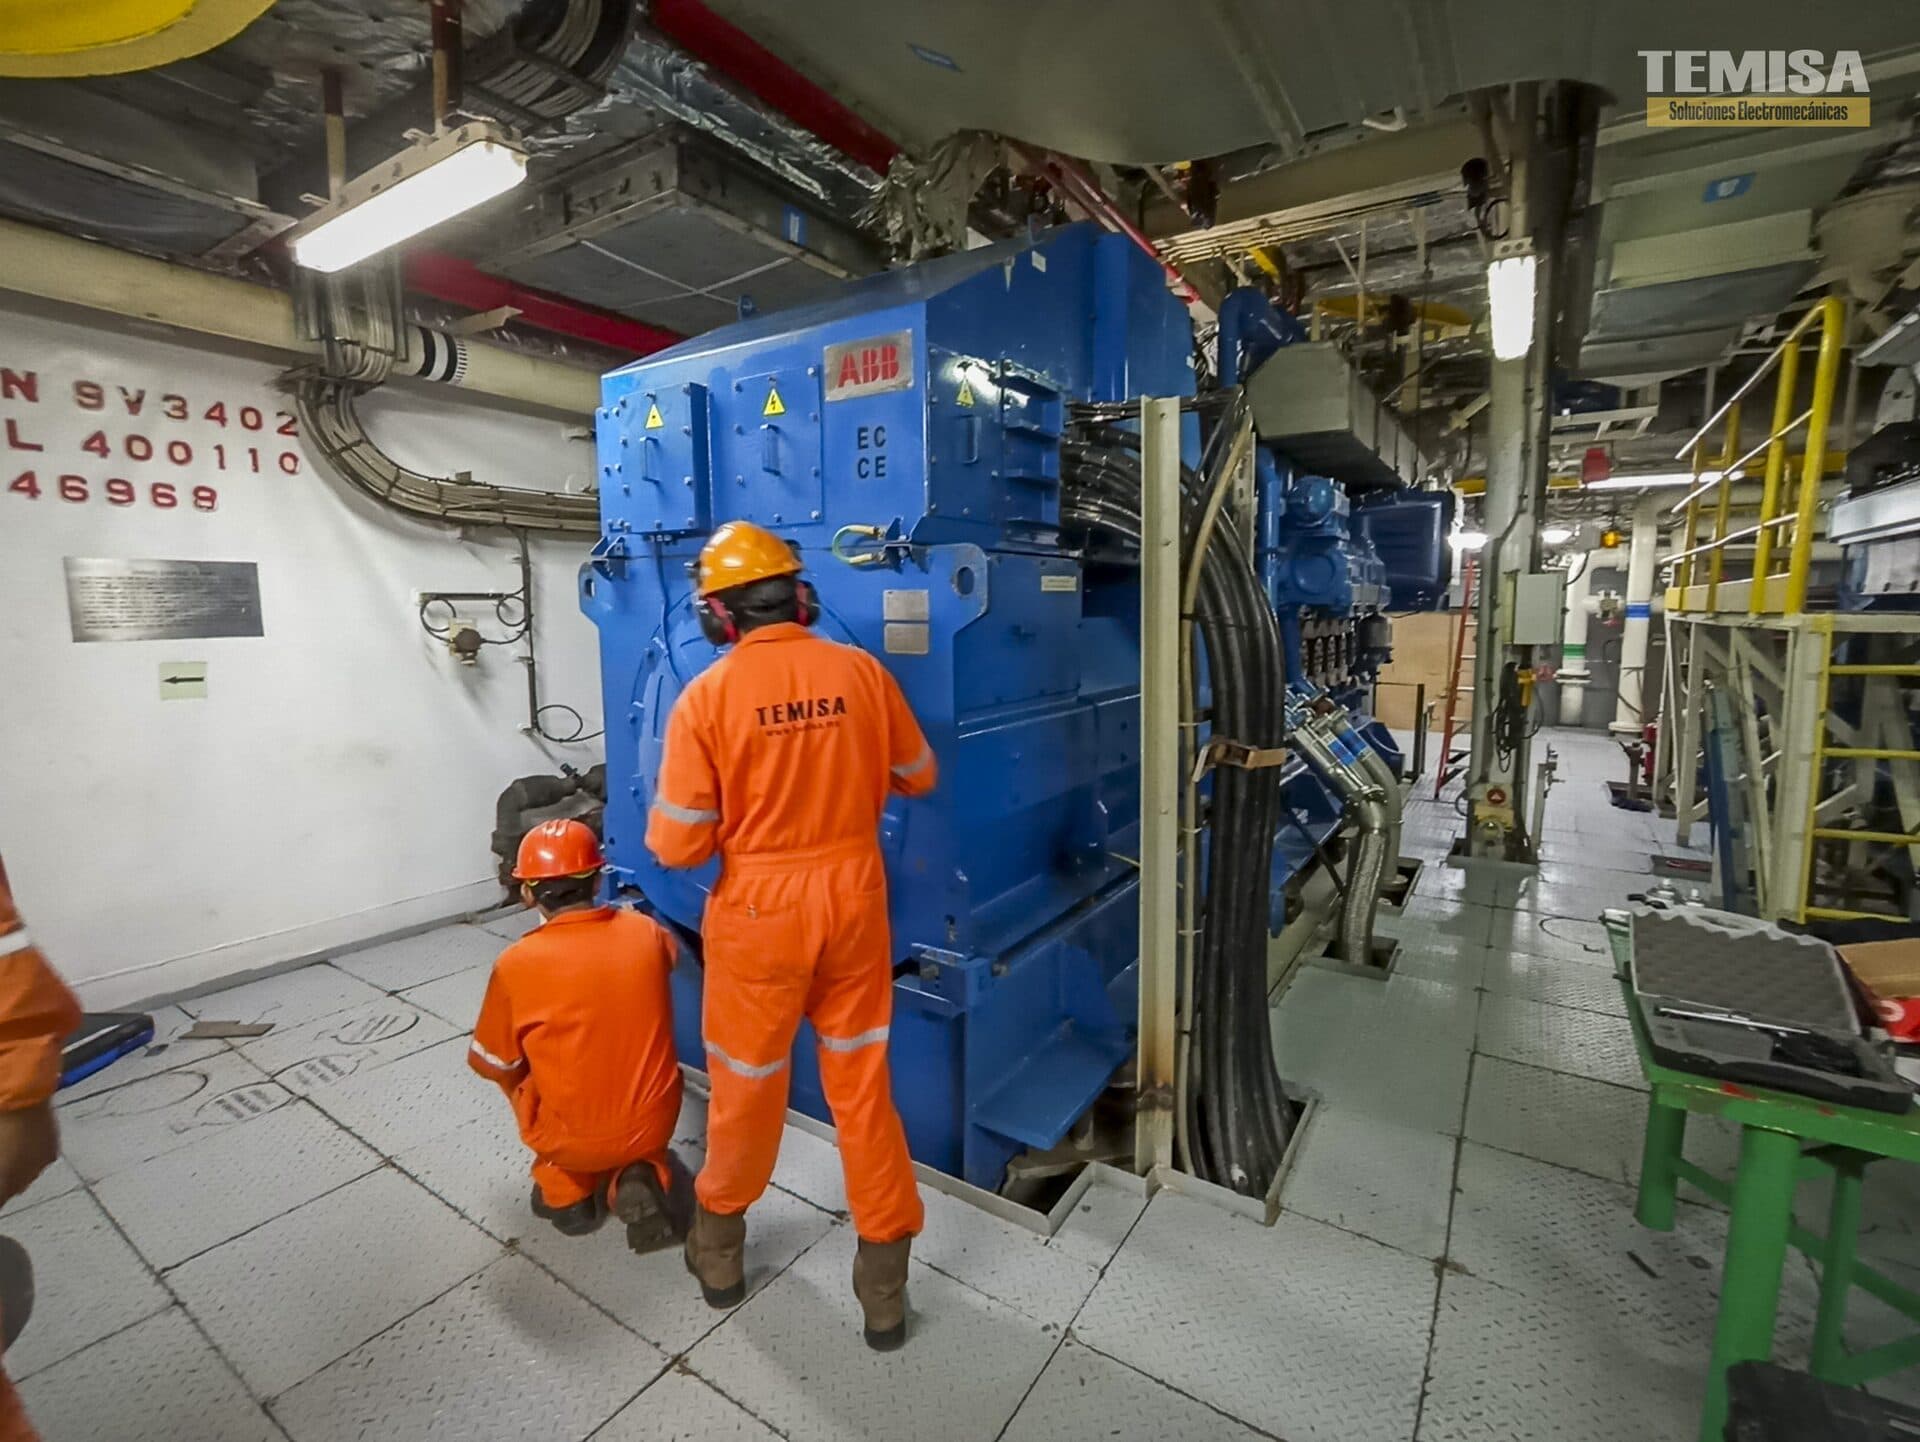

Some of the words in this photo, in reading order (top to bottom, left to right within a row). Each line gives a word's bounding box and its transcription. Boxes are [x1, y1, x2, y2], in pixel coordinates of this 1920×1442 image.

[838, 343, 899, 388] ABB
[5, 418, 44, 452] L
[82, 430, 299, 475] 400110
[857, 425, 886, 450] EC
[857, 456, 886, 479] CE
[9, 470, 217, 512] 46968
[755, 696, 846, 726] TEMISA
